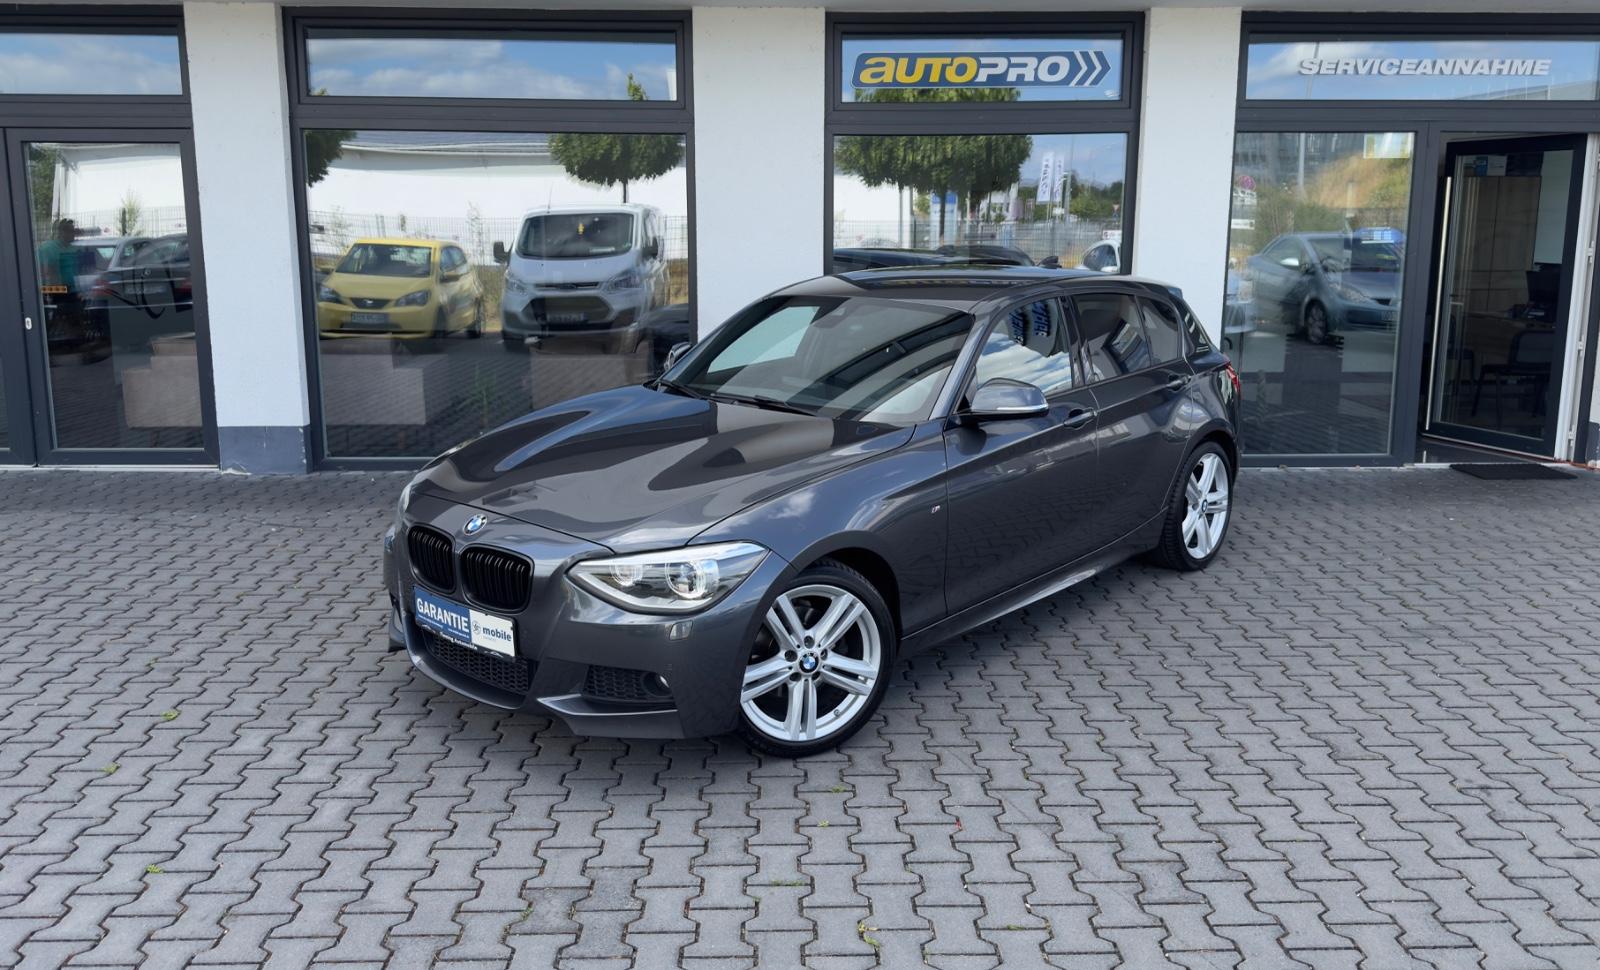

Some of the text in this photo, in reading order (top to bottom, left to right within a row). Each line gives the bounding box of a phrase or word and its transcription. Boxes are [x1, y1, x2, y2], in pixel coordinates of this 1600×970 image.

[1298, 57, 1552, 76] SERVICEANNAHME
[416, 598, 470, 633] GARANTIE
[482, 625, 512, 642] mobile
